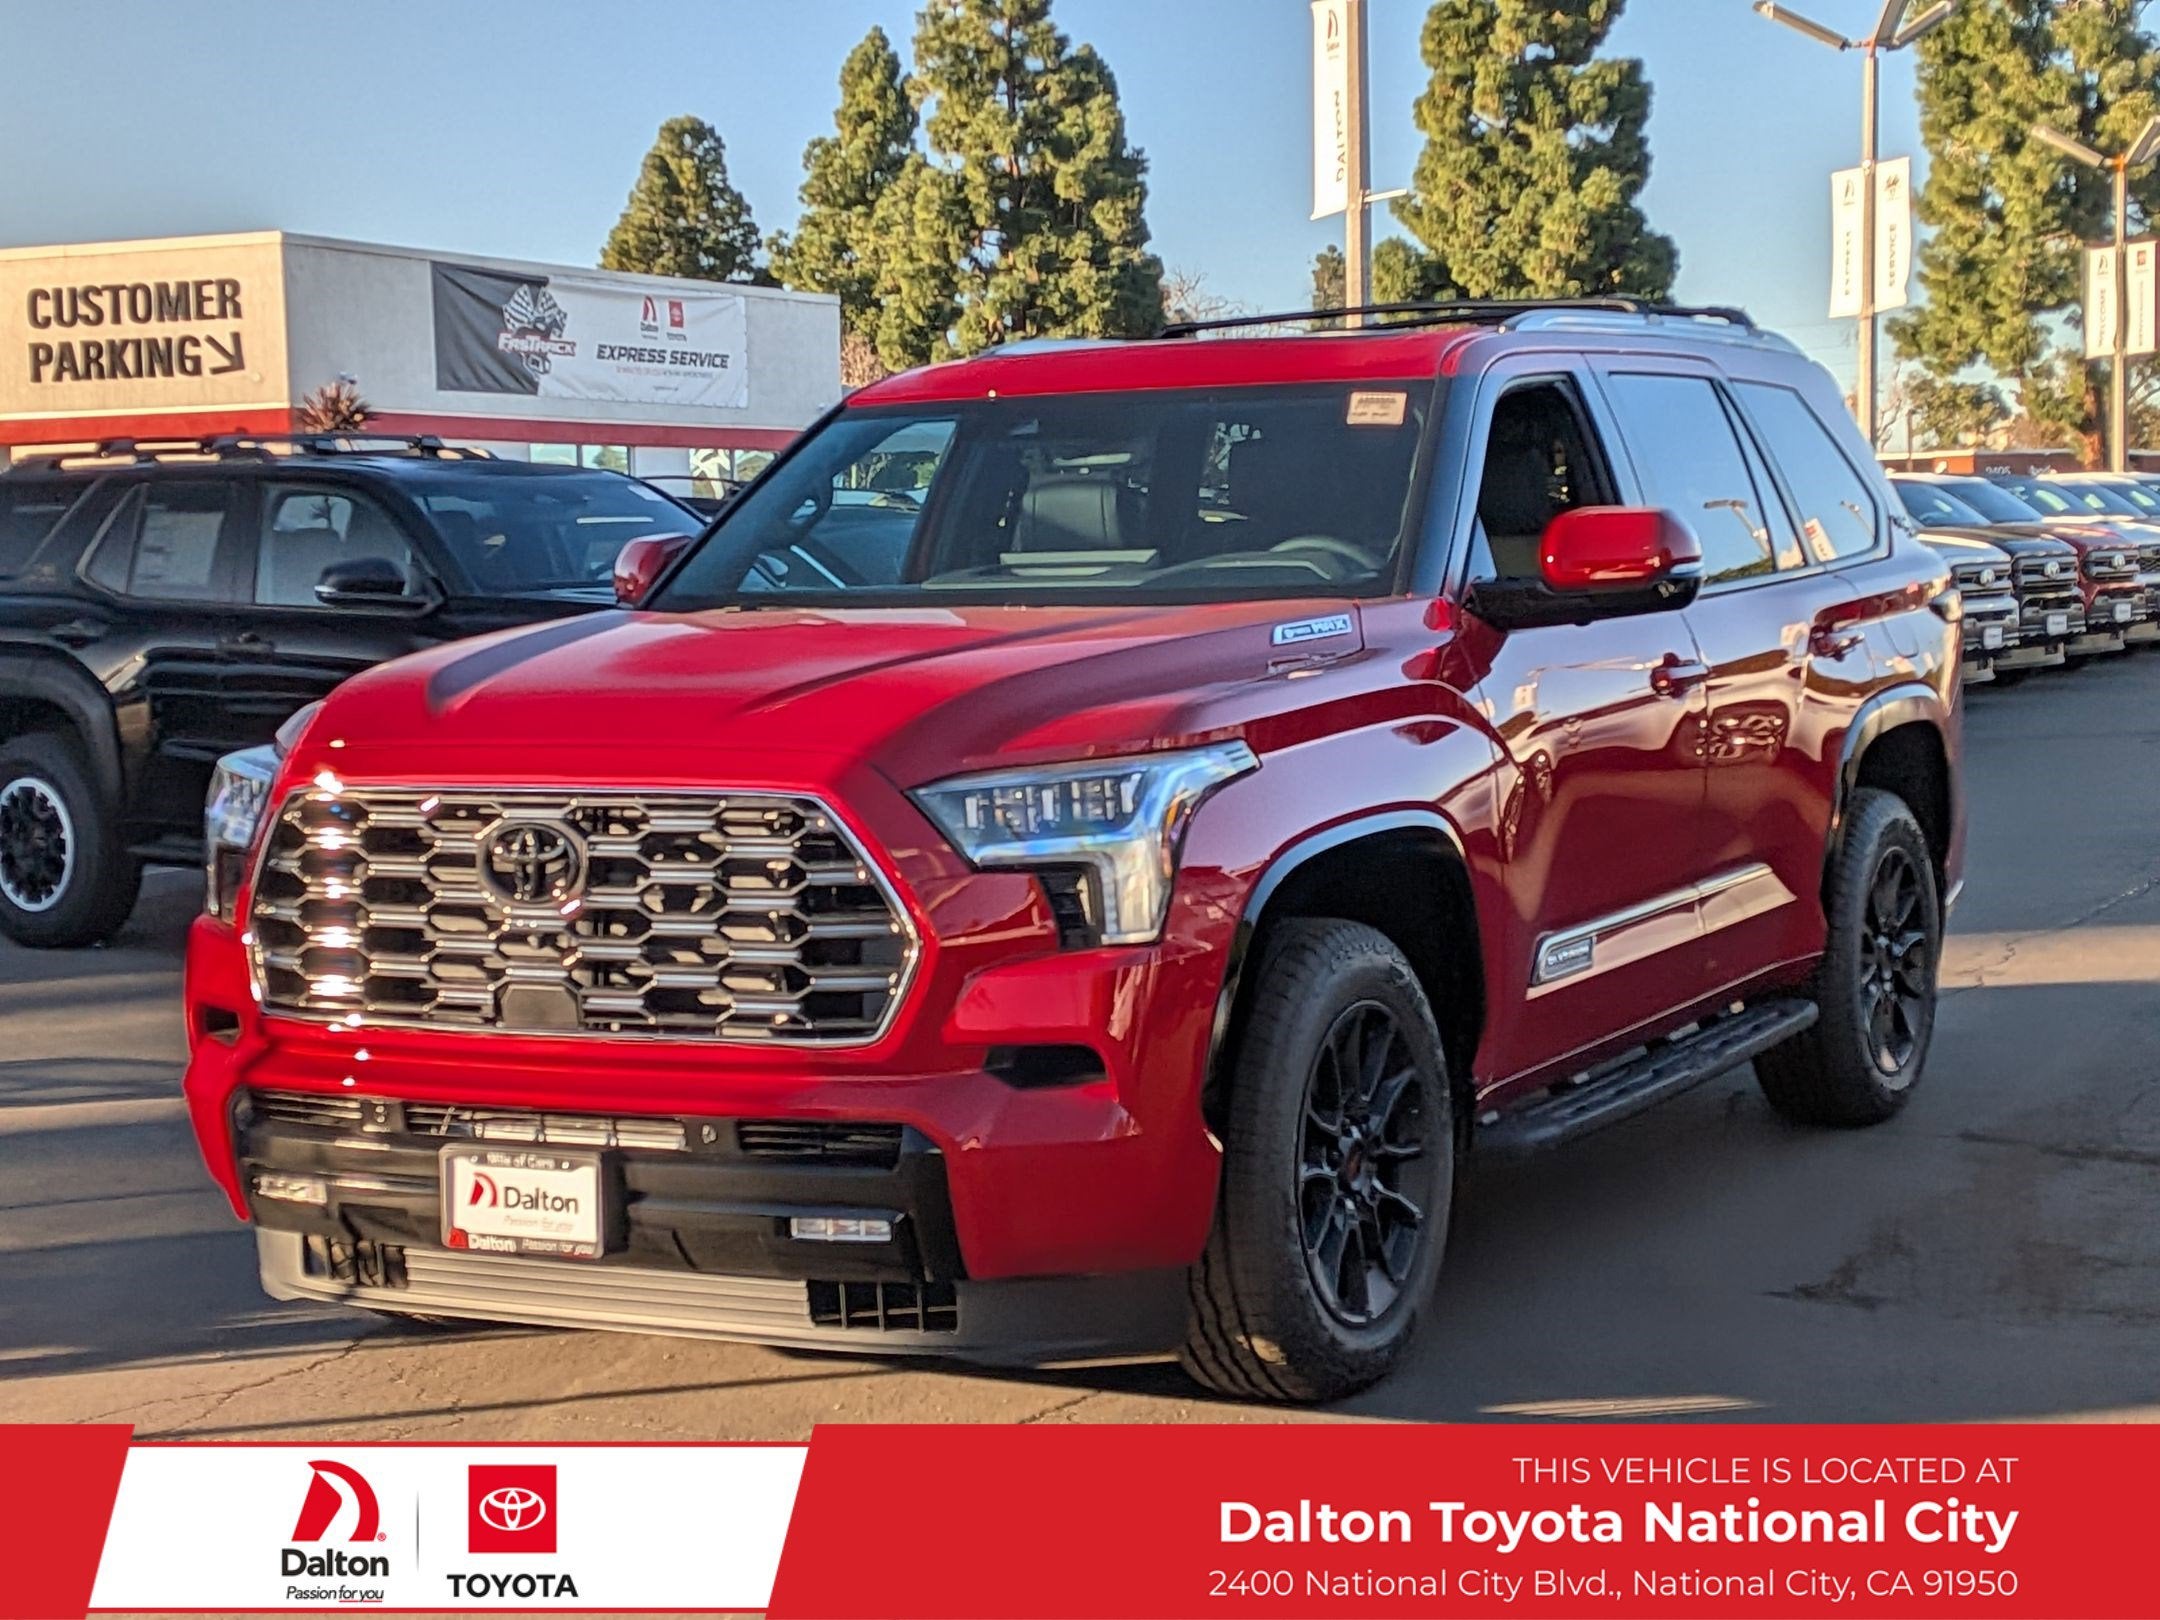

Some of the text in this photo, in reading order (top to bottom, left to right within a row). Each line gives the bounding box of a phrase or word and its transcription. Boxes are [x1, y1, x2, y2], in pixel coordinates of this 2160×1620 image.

[1888, 223, 1897, 288] SERVICE
[27, 278, 243, 330] CUSTOMER
[28, 334, 203, 383] PARKING
[596, 343, 730, 369] EXPRESS SERVICE
[503, 1185, 579, 1215] Dalton
[468, 1234, 517, 1253] Dalton
